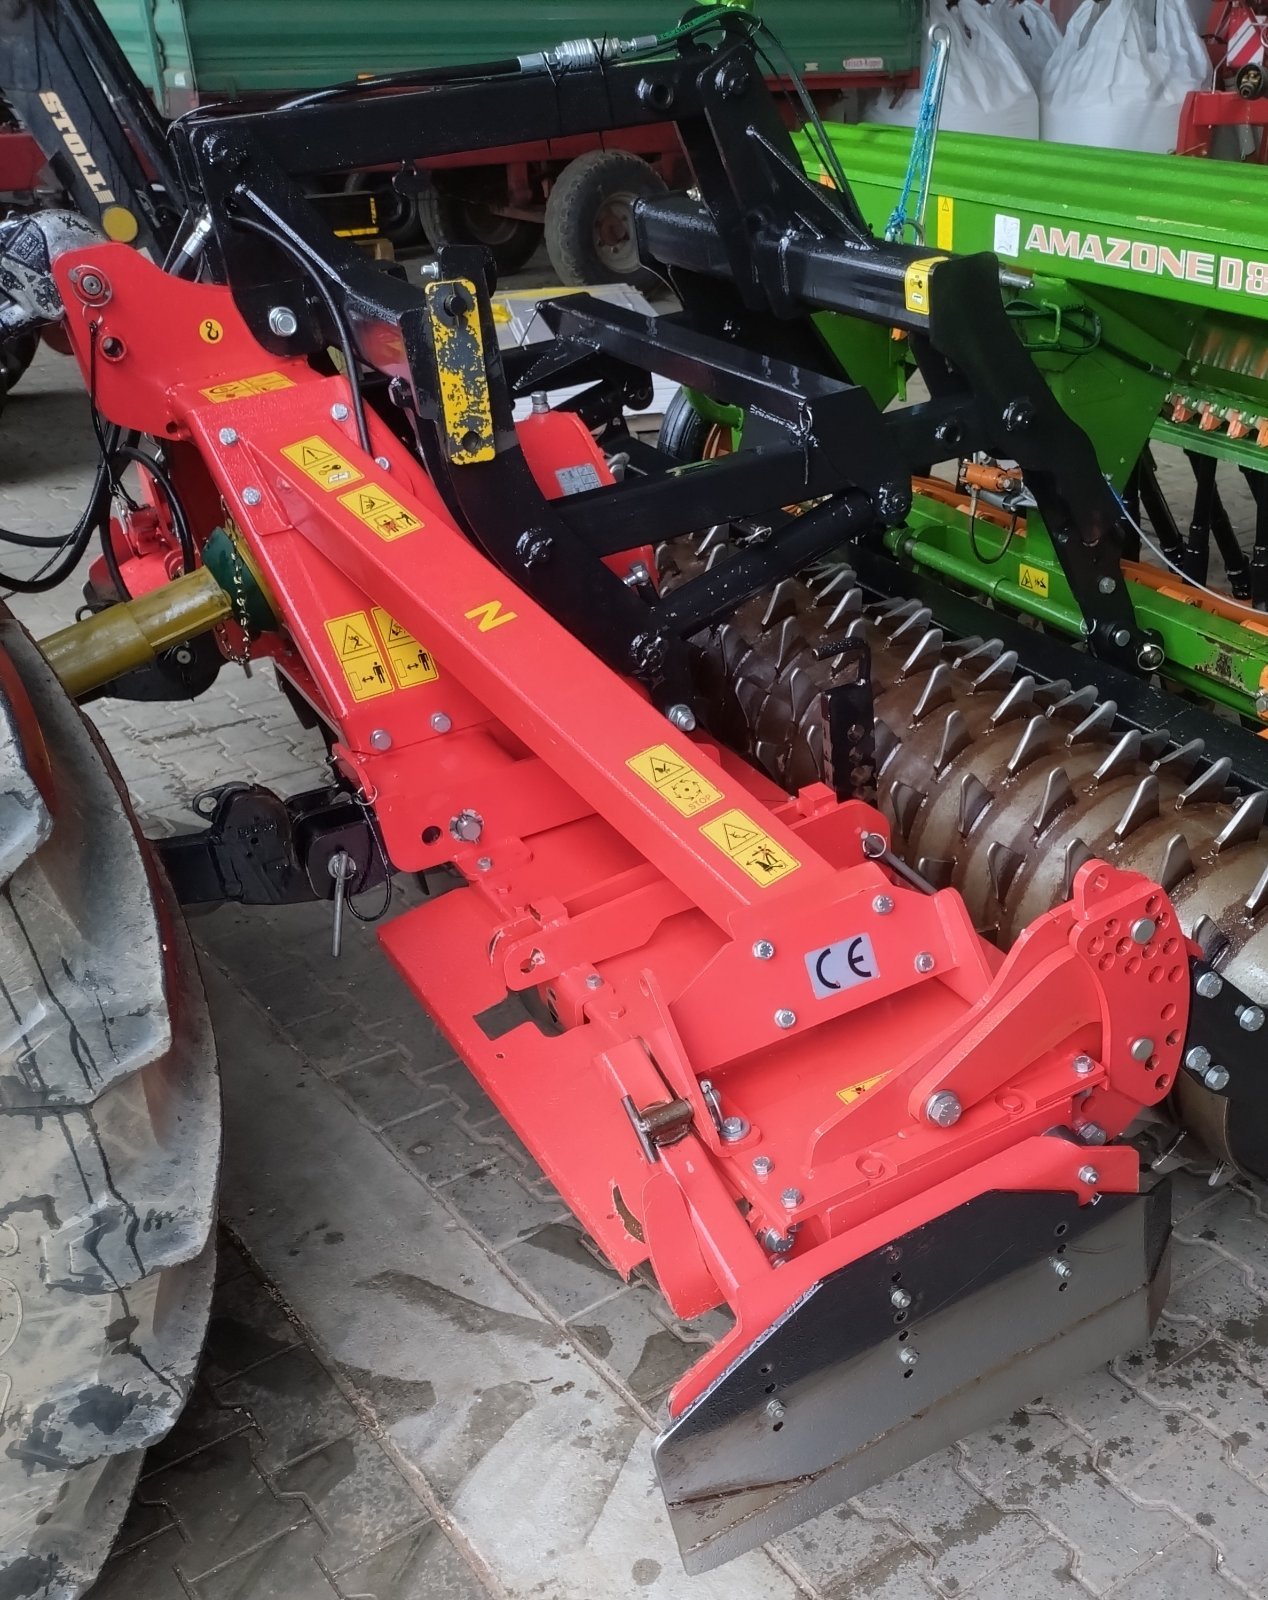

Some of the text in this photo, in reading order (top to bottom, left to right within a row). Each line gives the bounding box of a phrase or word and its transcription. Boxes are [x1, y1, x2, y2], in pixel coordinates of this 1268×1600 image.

[39, 91, 107, 193] STOLL
[1025, 224, 1215, 285] AMAZONE
[688, 793, 711, 809] STOP
[816, 937, 872, 989] CE
